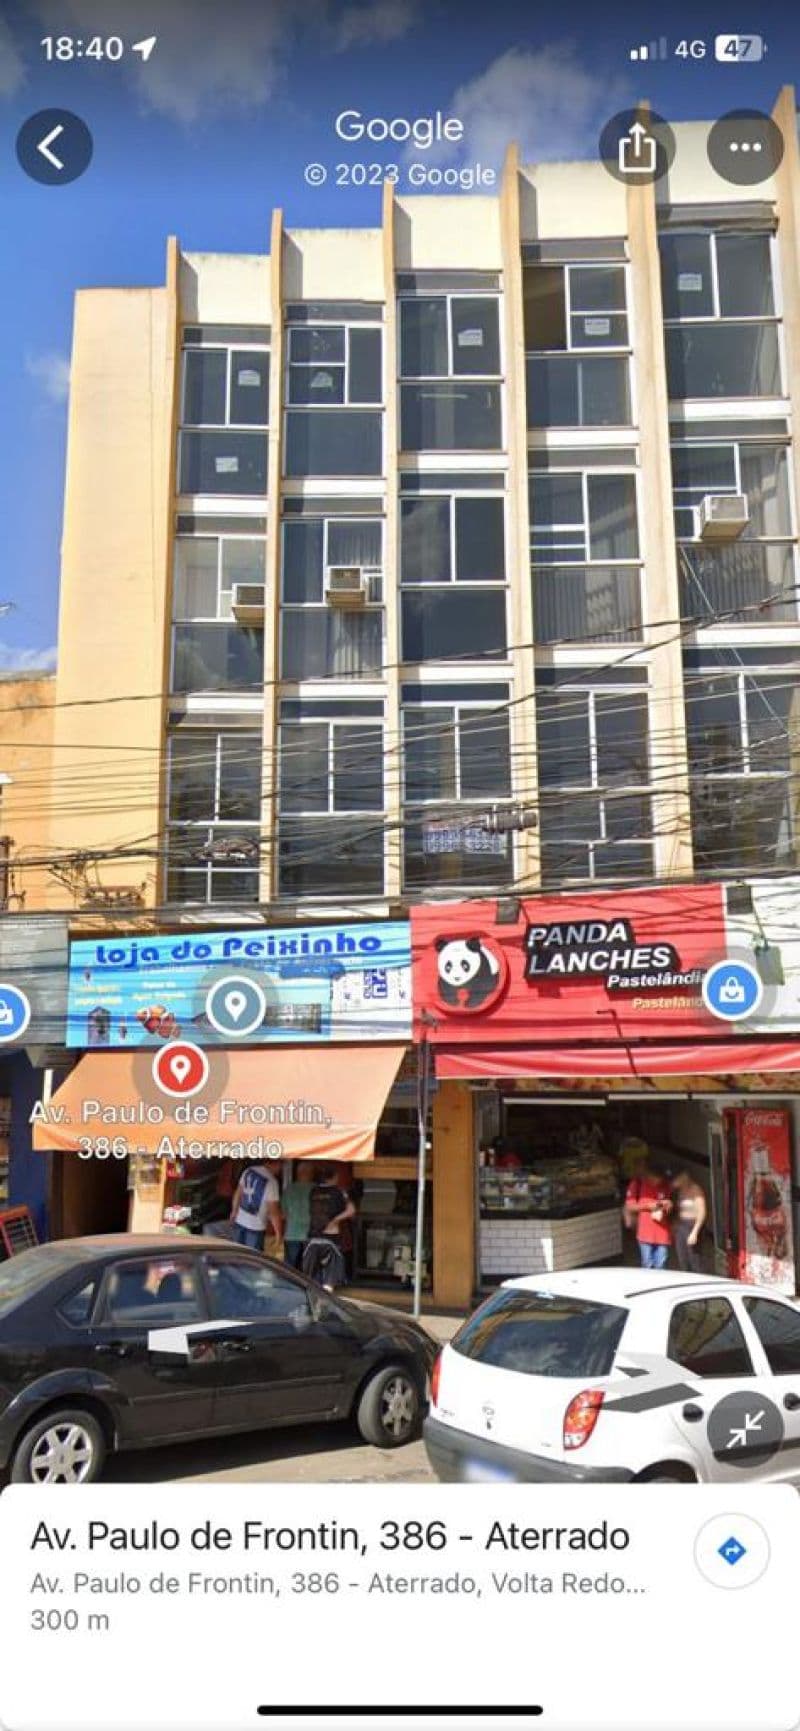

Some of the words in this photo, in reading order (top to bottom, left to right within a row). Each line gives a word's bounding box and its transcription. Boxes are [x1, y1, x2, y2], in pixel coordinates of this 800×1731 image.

[170, 940, 212, 961] do
[222, 932, 382, 957] Peixinho
[527, 922, 628, 948] PANDA
[528, 946, 671, 975] LANCHES
